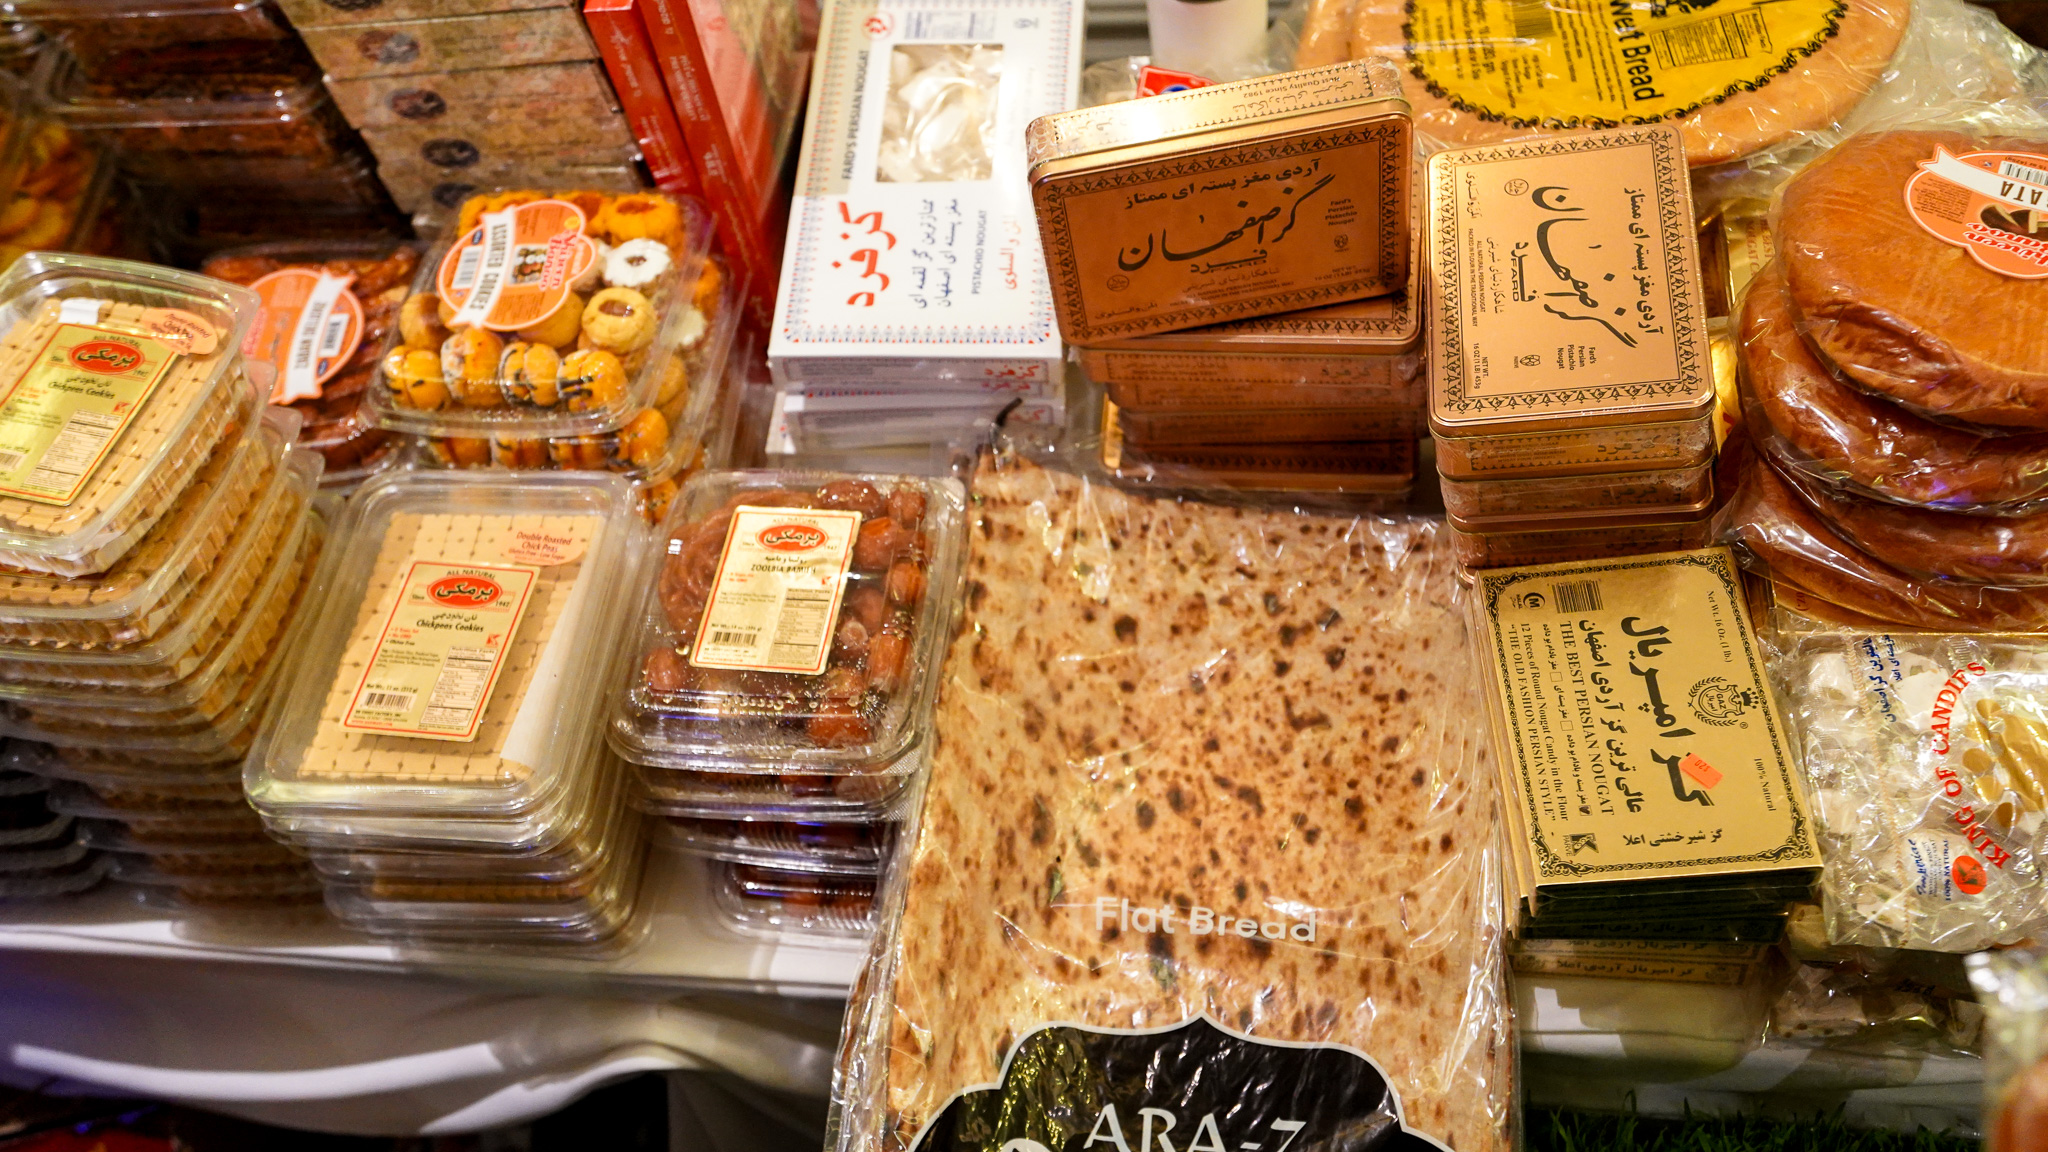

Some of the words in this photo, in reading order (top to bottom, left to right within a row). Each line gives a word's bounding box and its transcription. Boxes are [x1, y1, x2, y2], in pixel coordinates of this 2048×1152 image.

[854, 50, 869, 93] NOUGAT
[1622, 45, 1664, 101] Bread
[1265, 85, 1287, 94] Since
[1290, 78, 1320, 89] Quality
[1242, 90, 1263, 99] 1982
[847, 95, 863, 139] PERSIAN
[842, 141, 856, 180] FARD'S
[1275, 158, 1321, 182] آردی
[1200, 177, 1238, 195] پسته
[1241, 171, 1272, 188] مغز
[1124, 190, 1168, 210] ممتاز
[1172, 182, 1195, 201] ای
[2000, 180, 2048, 209] ATA
[1272, 173, 1337, 243] گز
[1327, 204, 1355, 214] Persian
[1330, 198, 1352, 207] Fard's
[1624, 187, 1646, 220] ممتاز
[838, 200, 896, 250] گز
[1324, 209, 1358, 221] Pistachio
[1328, 217, 1355, 227] Nougat
[947, 222, 962, 246] پسته
[976, 210, 987, 246] NOUGAT
[1628, 222, 1651, 239] ای
[487, 223, 507, 268] ASSORTED
[1487, 237, 1500, 263] شیرینی
[938, 251, 956, 263] ای
[1190, 248, 1269, 274] فرد
[1632, 243, 1648, 271] پسته
[831, 248, 890, 307] فرد
[971, 248, 985, 294] PISTACHIO
[1511, 242, 1540, 302] فرد
[1511, 257, 1519, 302] FARD
[469, 273, 499, 310] COOKIES
[935, 267, 953, 307] اصفهان
[1632, 274, 1655, 297] مغز
[908, 294, 927, 309] ای
[1543, 304, 1638, 349] گز
[1636, 300, 1664, 335] آردی
[76, 348, 136, 368] برمکی
[1474, 350, 1480, 358] OZ
[1557, 347, 1565, 369] Nougat
[1588, 346, 1597, 364] Fard's
[86, 387, 115, 400] Cookies
[516, 531, 542, 540] Double
[543, 535, 572, 546] Roasted
[522, 542, 540, 550] Chick
[542, 544, 558, 552] Peas
[765, 529, 819, 546] برمکی
[462, 569, 496, 579] NATURAL
[751, 564, 784, 573] ZOOLBIA
[436, 582, 494, 601] برمکی
[1515, 593, 1523, 610] HALAL
[1706, 590, 1716, 603] Net
[1711, 604, 1721, 617] Wt.
[455, 624, 484, 632] Cookies
[1521, 623, 1533, 632] 12
[1543, 624, 1551, 636] داده
[1714, 619, 1724, 627] 16
[1559, 621, 1576, 650] THE
[1578, 619, 1612, 667] اصفهان
[1717, 628, 1727, 641] Oz.
[1522, 634, 1539, 660] Pieces
[1546, 645, 1556, 659] بادام
[1722, 650, 1733, 663] lb.)
[1512, 653, 1526, 675] OLD
[1529, 661, 1540, 671] of
[1548, 660, 1558, 670] مغز
[1565, 652, 1584, 686] BEST
[1530, 672, 1545, 700] Round
[1620, 616, 1697, 738] امپریال
[1554, 685, 1564, 693] ای
[1590, 672, 1626, 712] آردی
[1516, 677, 1535, 726] FASHION
[1558, 695, 1566, 707] پسته
[1716, 693, 1726, 710] GAZ
[1874, 688, 1896, 723] اصفهان
[1930, 661, 1987, 755] CANDIES
[1533, 702, 1551, 734] Nougat
[1558, 709, 1569, 719] مغز
[1572, 690, 1599, 750] PERSIAN
[1600, 717, 1628, 734] گز
[1540, 736, 1557, 766] Candy
[1567, 735, 1575, 748] داده
[1527, 728, 1546, 776] PERSIAN
[1606, 739, 1636, 772] ترین
[1550, 767, 1561, 776] in
[1570, 757, 1581, 772] بادام
[1552, 779, 1565, 794] the
[1576, 779, 1584, 792] پسته
[1588, 754, 1614, 816] NOUGAT
[1650, 748, 1715, 807] گز
[1753, 757, 1765, 780] 100%
[1760, 781, 1775, 812] Natural
[1935, 766, 1962, 797] OF
[1577, 794, 1588, 804] مغز
[1615, 777, 1645, 814] عالی
[1555, 796, 1569, 821] Flour
[1623, 834, 1646, 846] اعلا
[1650, 830, 1683, 846] خشتی
[1683, 831, 1706, 844] شیر
[1710, 828, 1722, 841] گز
[1954, 805, 2012, 869] KING
[1562, 835, 1572, 857] PARVE
[1094, 896, 1179, 934] Flat
[1188, 906, 1318, 944] Bread
[1626, 964, 1675, 975] امپریال
[1083, 1102, 1307, 1152] ARA-7
